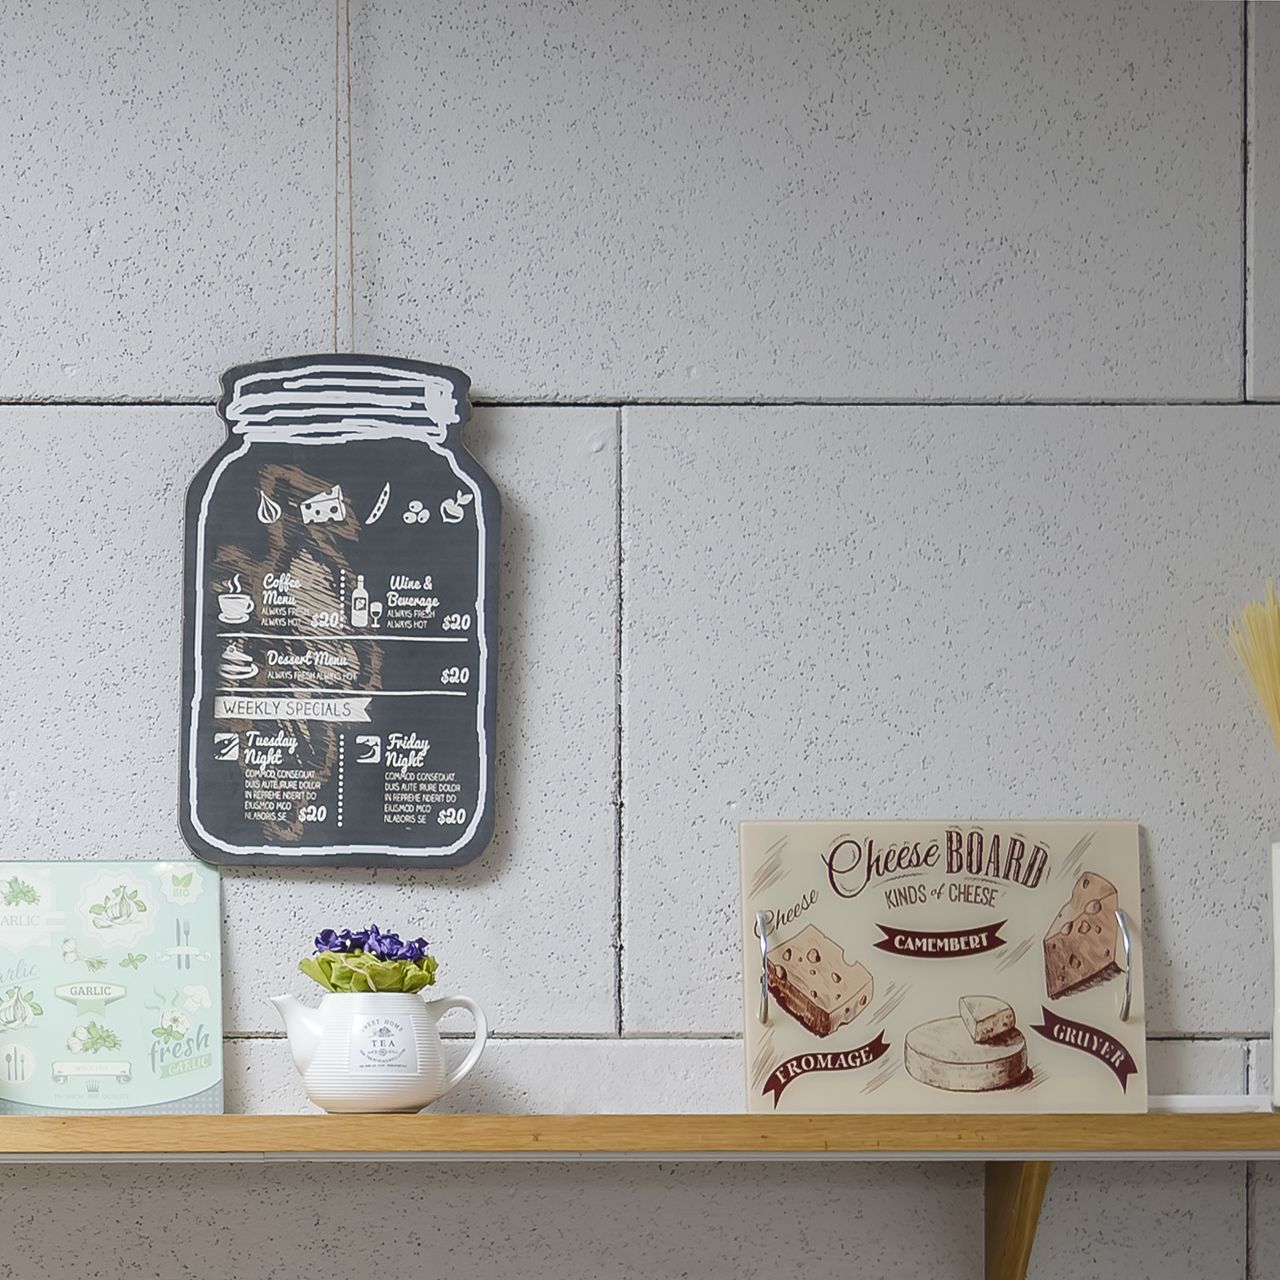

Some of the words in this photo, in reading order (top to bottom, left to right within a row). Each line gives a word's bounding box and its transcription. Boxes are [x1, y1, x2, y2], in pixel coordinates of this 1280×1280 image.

[263, 573, 302, 594] Coffee
[390, 576, 421, 590] Wine
[262, 591, 297, 605] Menu
[386, 592, 440, 613] Beverage
[311, 612, 339, 628] $20
[414, 620, 427, 629] HOT
[442, 614, 471, 631] $20
[267, 650, 312, 667] Dessert
[313, 651, 349, 666] Menu
[441, 667, 469, 684] $20
[223, 701, 281, 715] WEEKLY
[286, 701, 351, 717] SPECIALS
[245, 731, 298, 754] Tuesday
[386, 733, 430, 756] Friday
[244, 749, 283, 774] Night
[385, 752, 425, 777] Night
[298, 806, 327, 823] $20
[438, 808, 466, 825] $20
[821, 834, 940, 899] Cheese
[945, 829, 1051, 889] BOARD
[172, 888, 190, 897] BIO
[885, 886, 926, 910] KINDS
[930, 885, 944, 901] of
[949, 885, 999, 909] CHEESE
[753, 888, 819, 940] Cheese
[893, 932, 989, 953] CAMEMBERT
[70, 986, 112, 996] GARLIC
[150, 1024, 210, 1073] fresh
[1053, 1024, 1124, 1068] GRUYER
[168, 1056, 209, 1076] GARLIC
[776, 1045, 874, 1086] FROMAGE
